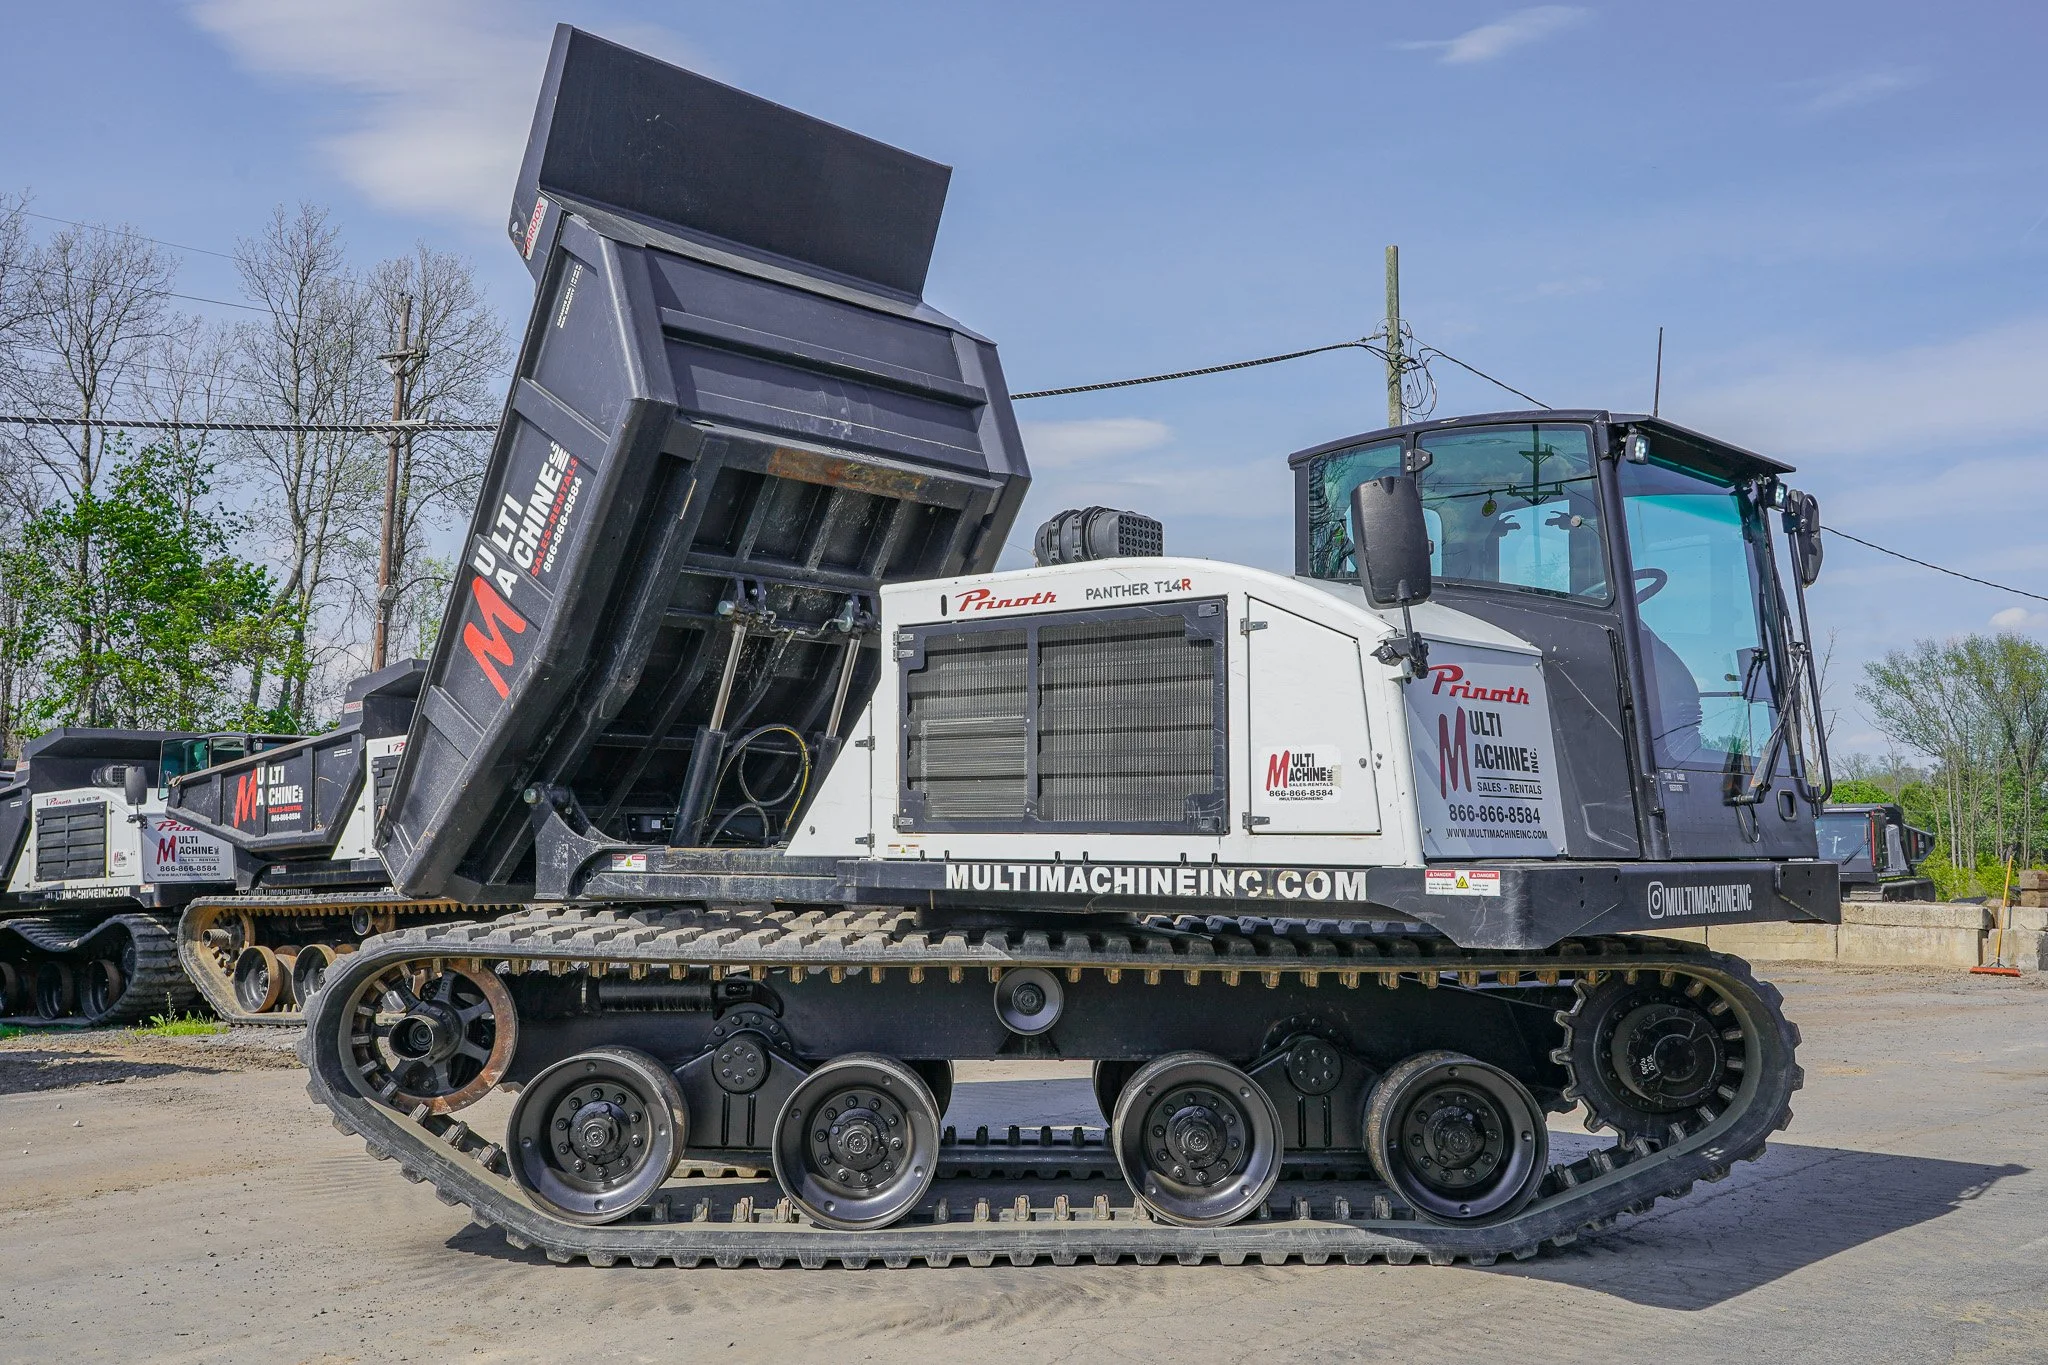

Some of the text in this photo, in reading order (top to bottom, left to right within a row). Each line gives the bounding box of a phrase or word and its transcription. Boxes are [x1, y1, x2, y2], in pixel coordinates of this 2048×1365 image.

[543, 477, 583, 573] 866-866-8584
[955, 578, 1192, 612] Prinoth PANTHER T14R
[1428, 664, 1530, 705] Prinoth
[1530, 748, 1540, 774] INC.
[1477, 782, 1502, 793] SALES
[1509, 784, 1542, 795] RENTALS
[1448, 804, 1540, 824] 866-866-8584
[1446, 828, 1548, 839] WWW.MULTIMACHINEINC.COM
[944, 864, 1366, 901] MULTIMACHINEINC.COM
[1665, 884, 1752, 917] MULTIMACHINEINC
